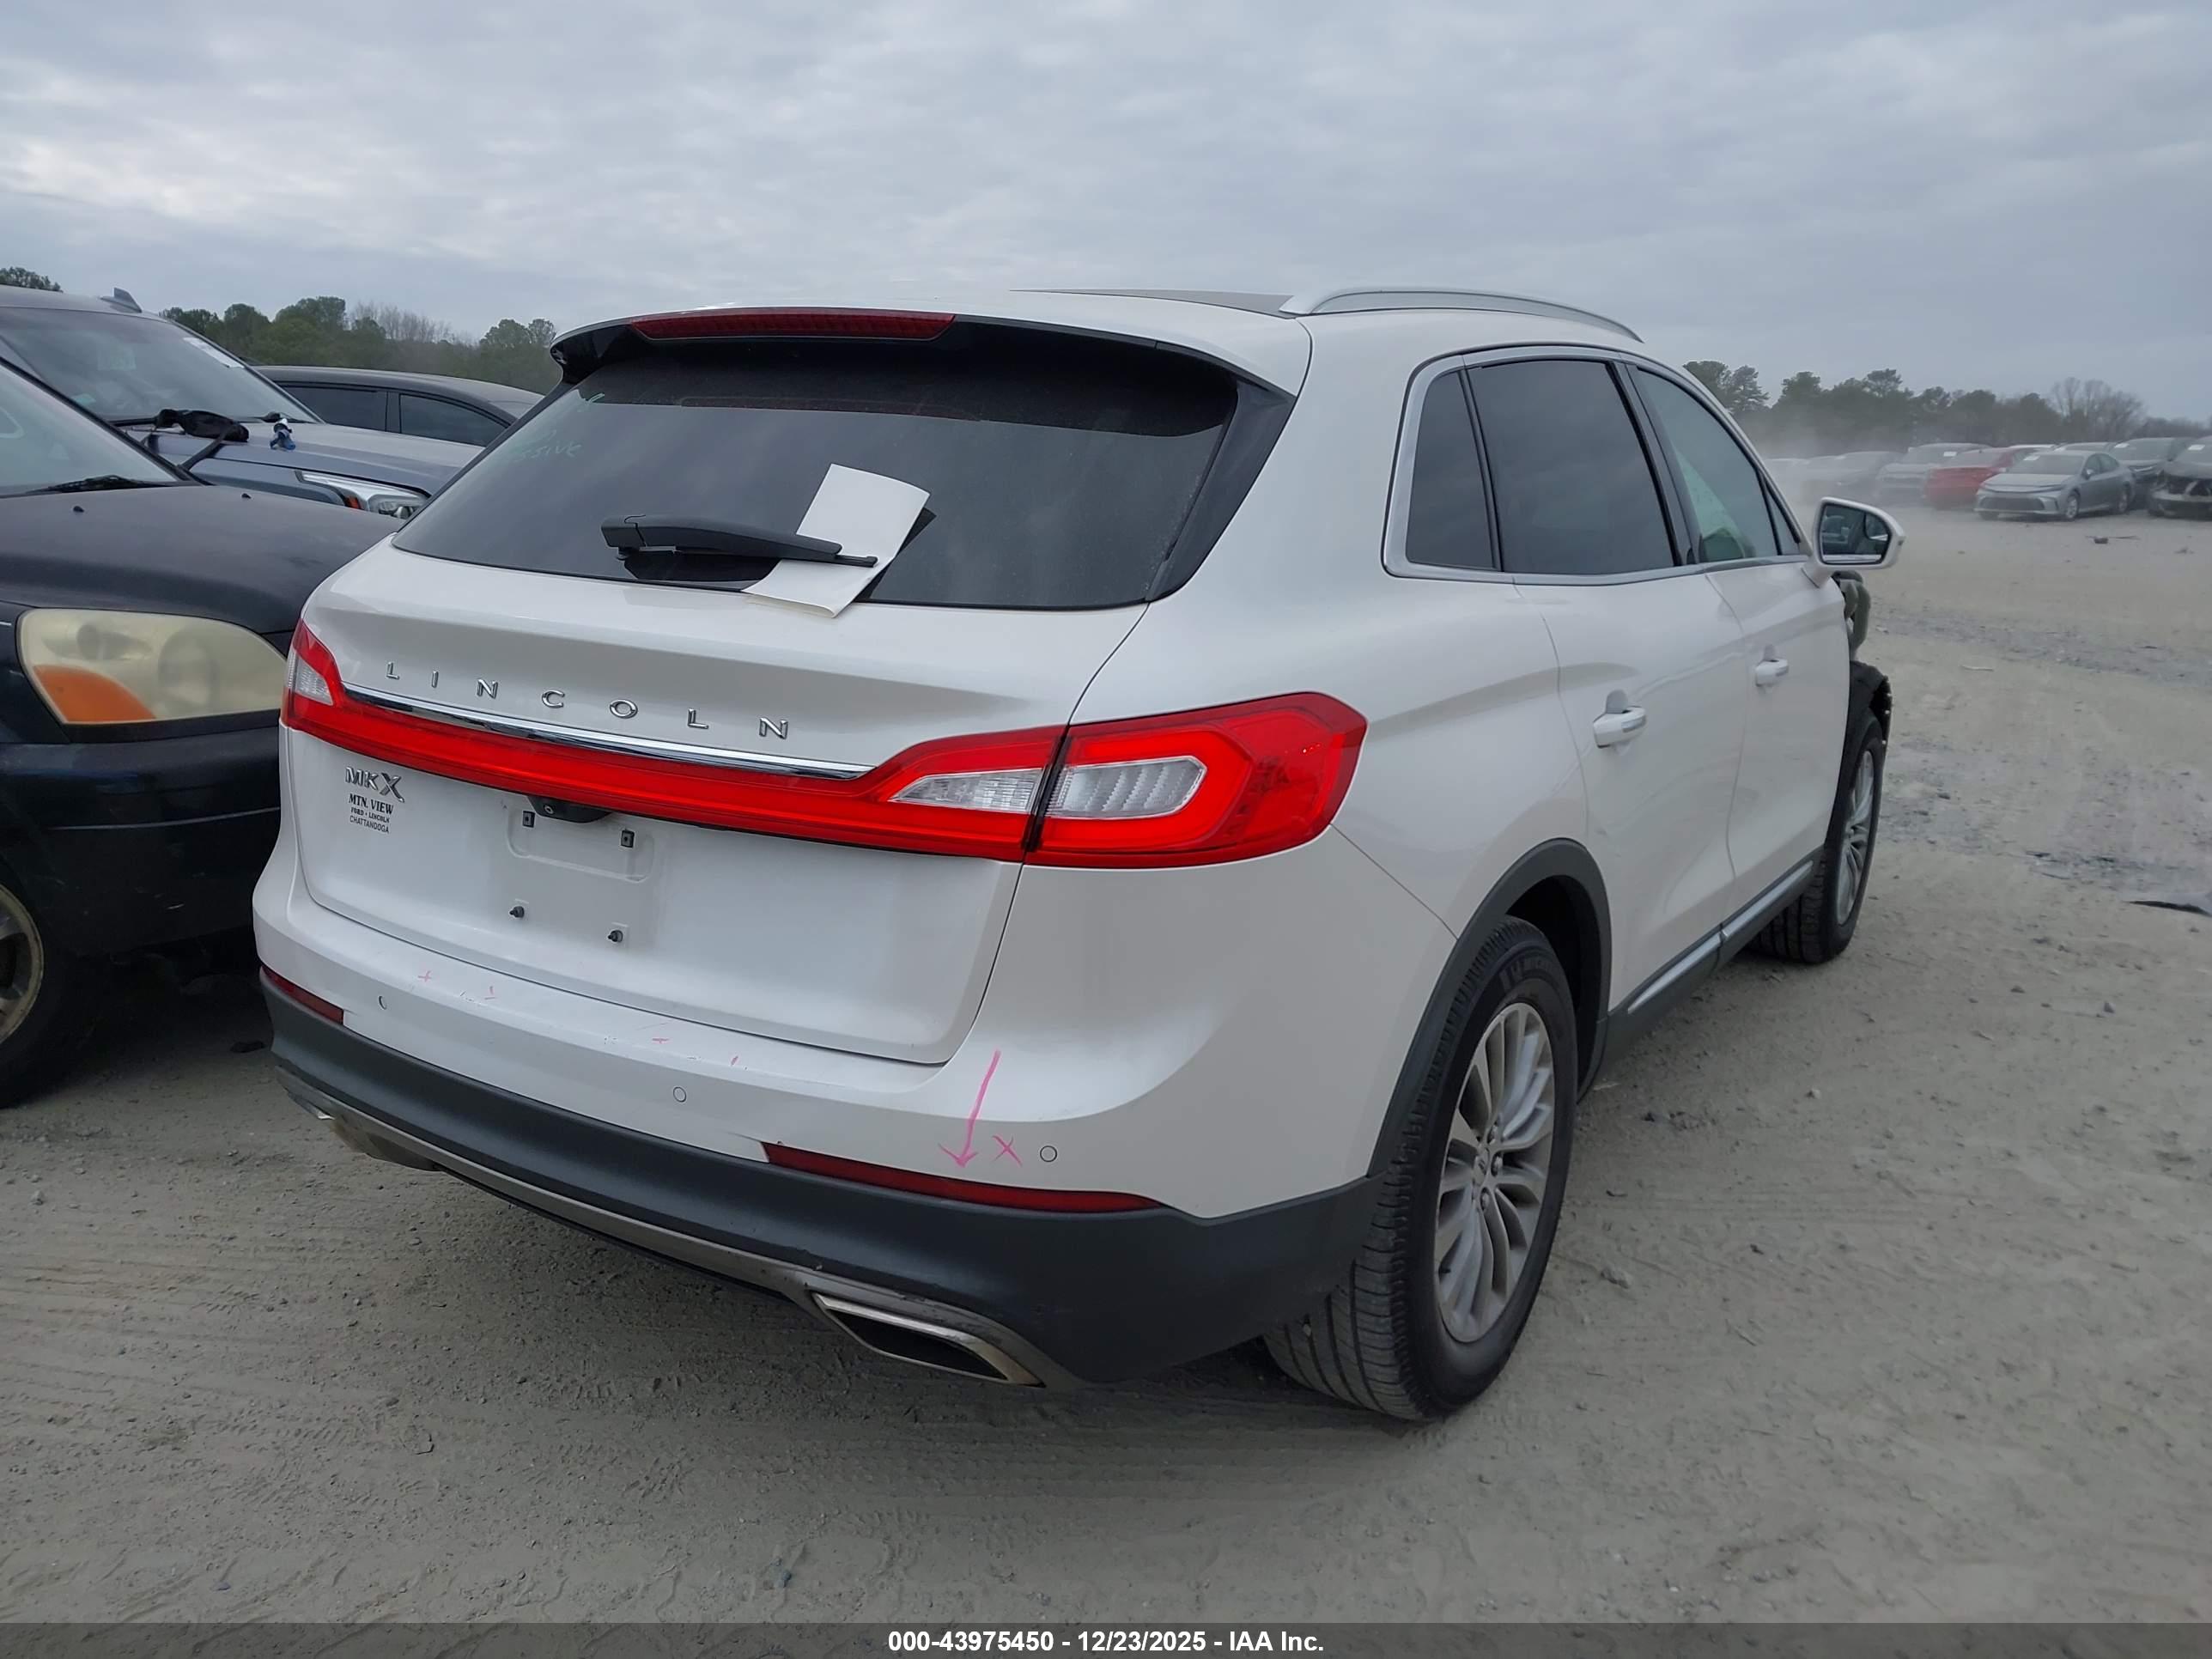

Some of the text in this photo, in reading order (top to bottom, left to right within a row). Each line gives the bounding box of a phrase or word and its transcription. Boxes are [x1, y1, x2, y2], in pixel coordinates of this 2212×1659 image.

[386, 662, 789, 740] LINCOLN
[345, 766, 405, 803] MKX
[349, 793, 394, 815] MTN. VIEW
[349, 815, 390, 834] CHATTANOOGA
